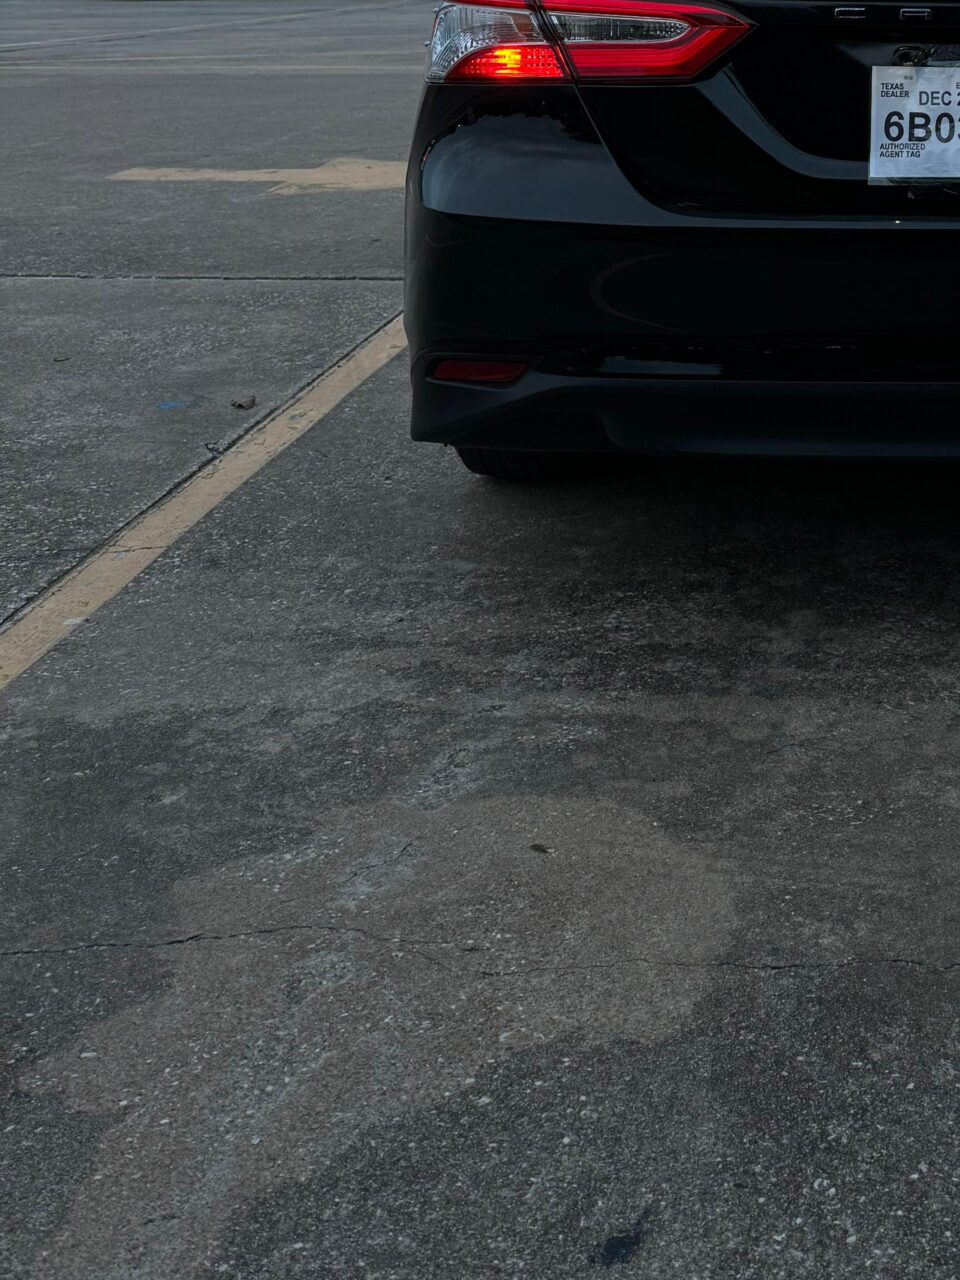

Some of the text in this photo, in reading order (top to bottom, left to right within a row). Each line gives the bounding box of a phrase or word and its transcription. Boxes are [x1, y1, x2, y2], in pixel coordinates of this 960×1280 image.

[880, 90, 910, 98] DEALER
[919, 91, 952, 106] DEC
[879, 143, 926, 151] AUTHORIZED
